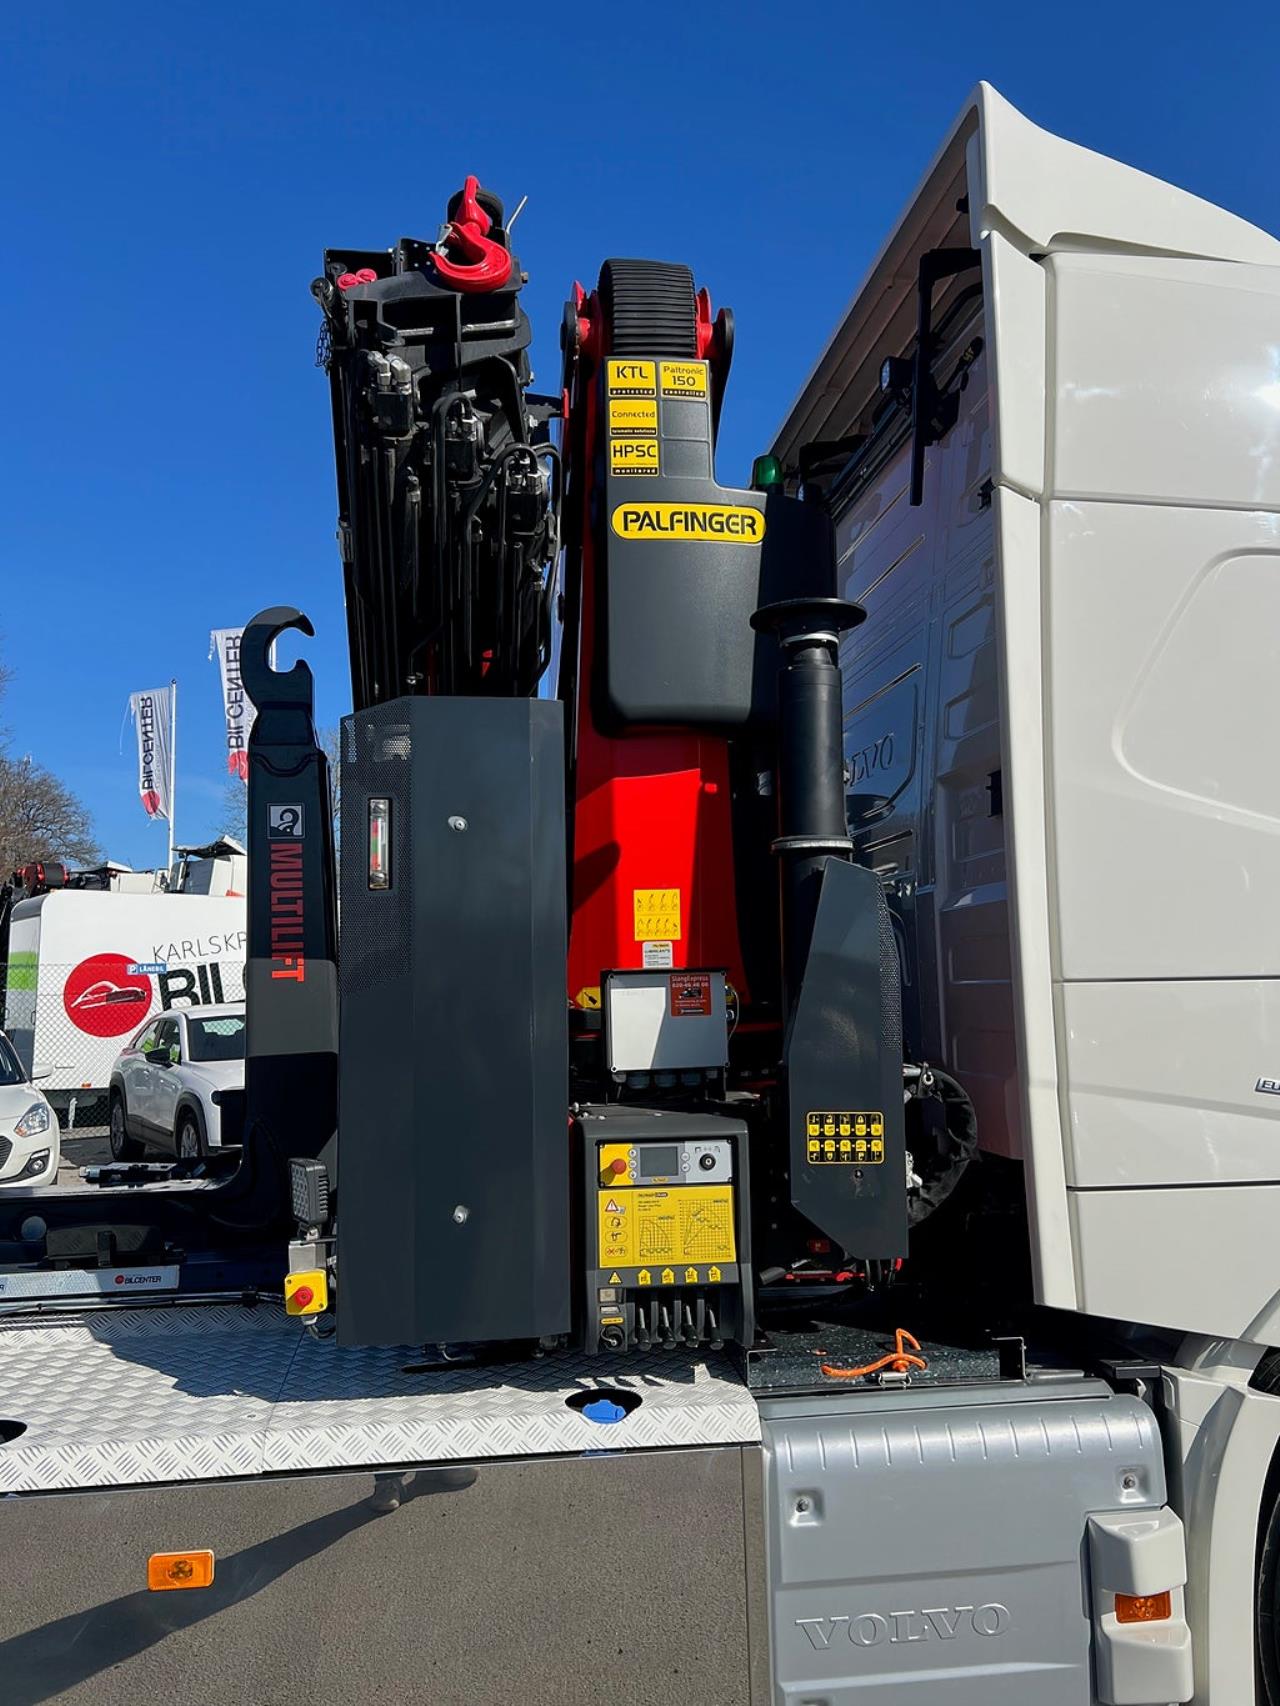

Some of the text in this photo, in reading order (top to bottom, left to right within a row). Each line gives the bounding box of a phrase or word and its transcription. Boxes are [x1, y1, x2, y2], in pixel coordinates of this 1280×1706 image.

[616, 365, 648, 379] KTL
[663, 365, 704, 376] Paltronic
[672, 375, 696, 387] 150
[611, 410, 655, 418] Connected
[613, 444, 656, 458] HPSC
[622, 510, 757, 536] PALFINGER
[270, 843, 305, 983] MULTILIFT
[124, 1275, 162, 1285] BILCENTER
[795, 1601, 1011, 1650] VOLVO
